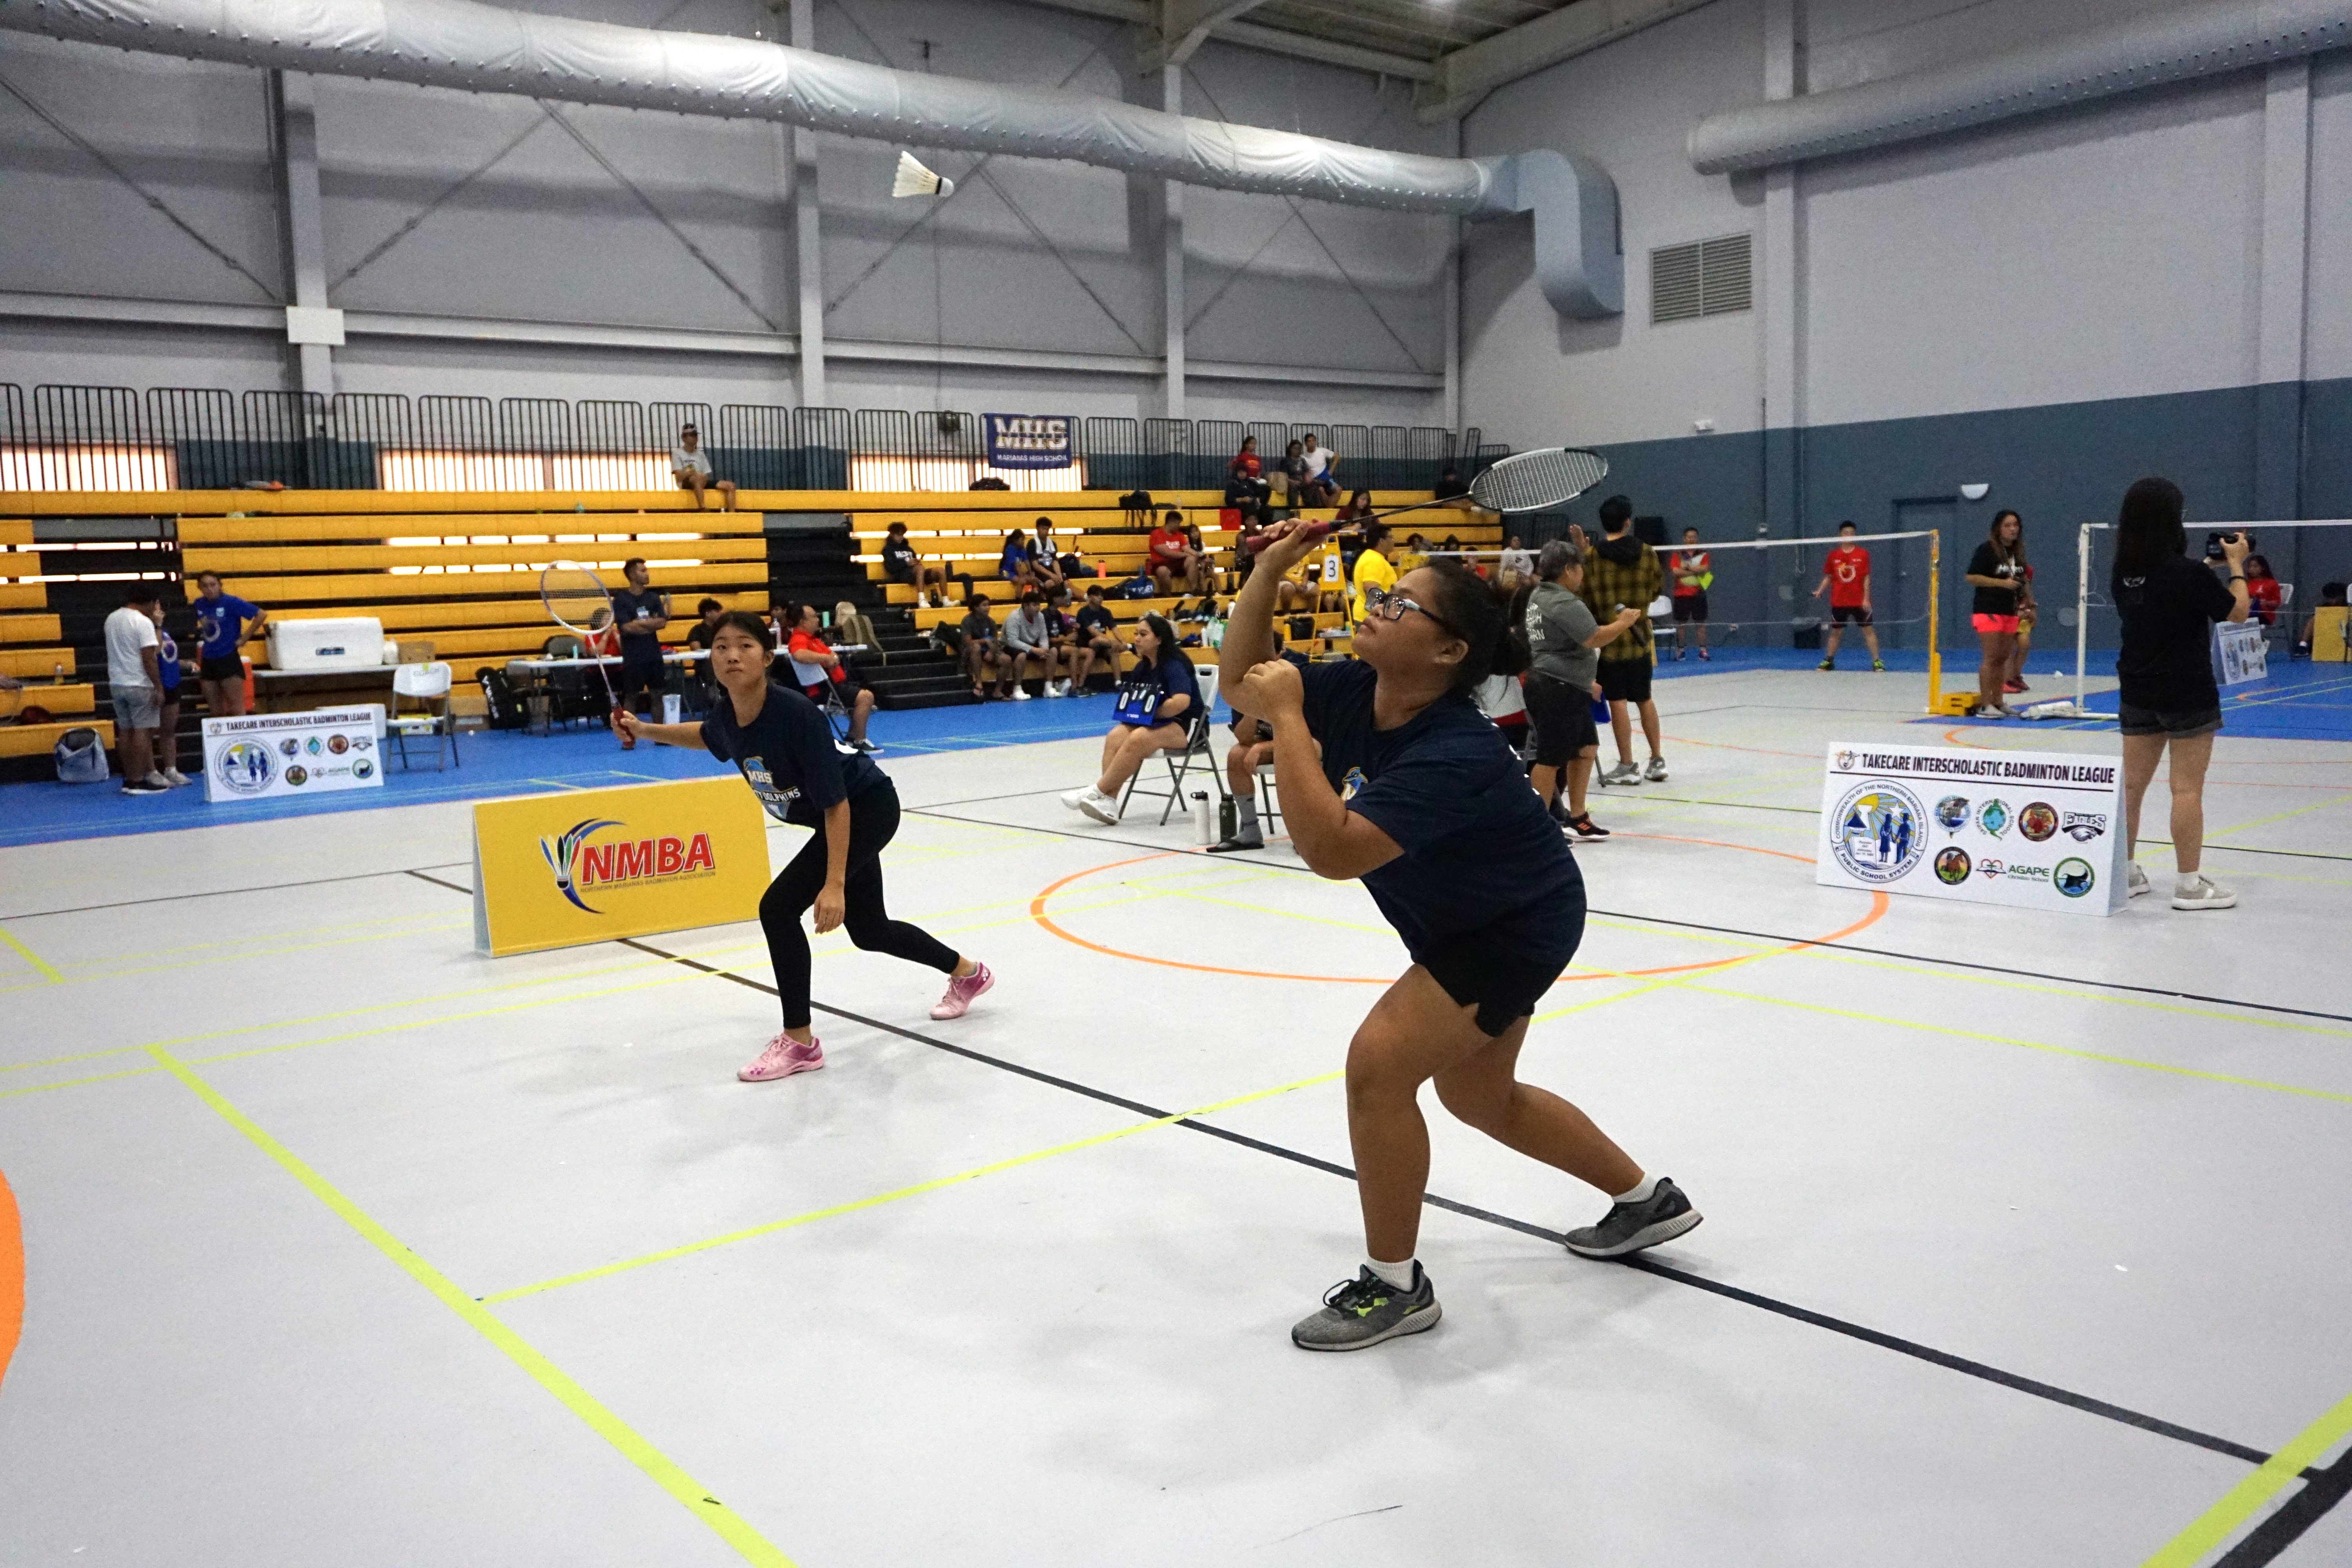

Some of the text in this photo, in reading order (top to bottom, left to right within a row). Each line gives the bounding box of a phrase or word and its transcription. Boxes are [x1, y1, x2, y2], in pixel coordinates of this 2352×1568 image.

[995, 417, 1068, 449] MHS
[1328, 560, 1336, 577] 3
[226, 711, 372, 731] TAKECARE INTERSCHOLASTIC BADMINTON LEAGUE
[747, 770, 773, 784] MHS
[1863, 753, 2115, 783] TAKECARE INTERSCHOLASTIC BADMINTON LEAGUE
[763, 788, 801, 802] DOLPHINS
[1835, 793, 1856, 839] COMMONWEALTH
[1877, 784, 1907, 797] NORTHERN
[1907, 796, 1923, 821] MARIANA
[1976, 817, 1987, 835] SAIPAN
[2000, 816, 2015, 836] SCHOOL
[581, 833, 715, 886] NMBA
[1841, 853, 1859, 873] PUBLIC
[1861, 869, 1887, 879] SCHOOL
[1889, 860, 1913, 878] SYSTEM
[2008, 864, 2050, 877] AGAPE
[581, 871, 716, 893] NORTHERN MARIANAS BADMINTON ASSOCIATION
